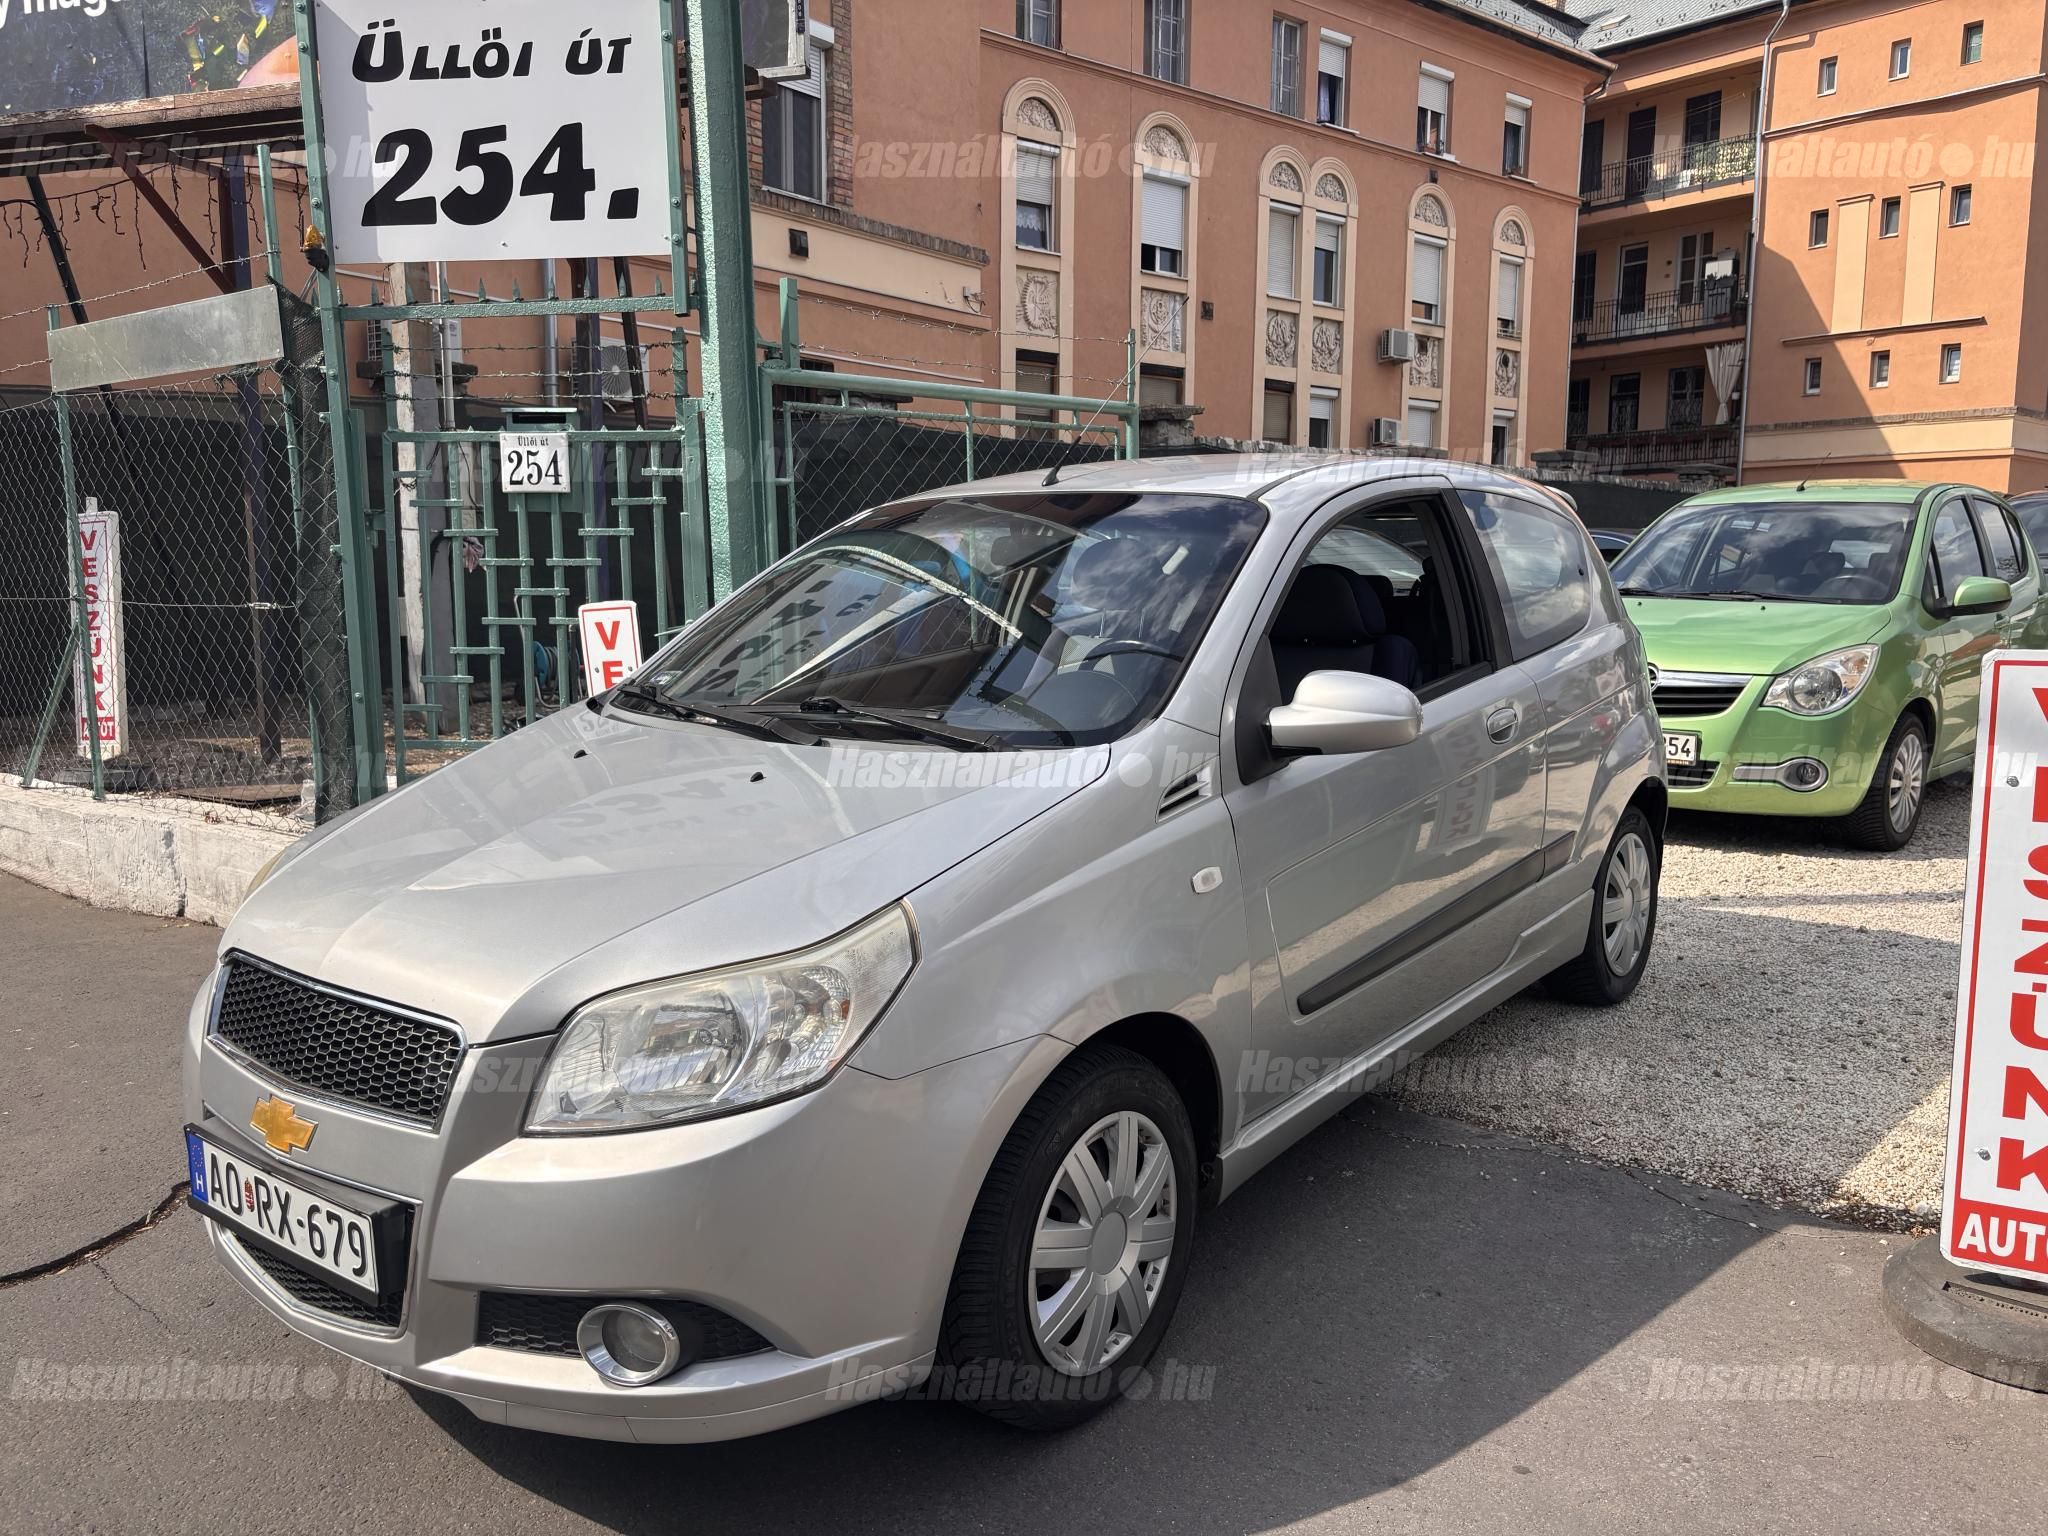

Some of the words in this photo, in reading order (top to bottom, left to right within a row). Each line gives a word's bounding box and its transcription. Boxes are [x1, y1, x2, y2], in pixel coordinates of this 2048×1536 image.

[565, 27, 632, 76] ÚT
[361, 122, 639, 227] 254.
[508, 449, 562, 485] 254
[1664, 737, 1691, 757] 54
[195, 1172, 205, 1193] H
[1958, 1212, 2048, 1262] AUT
